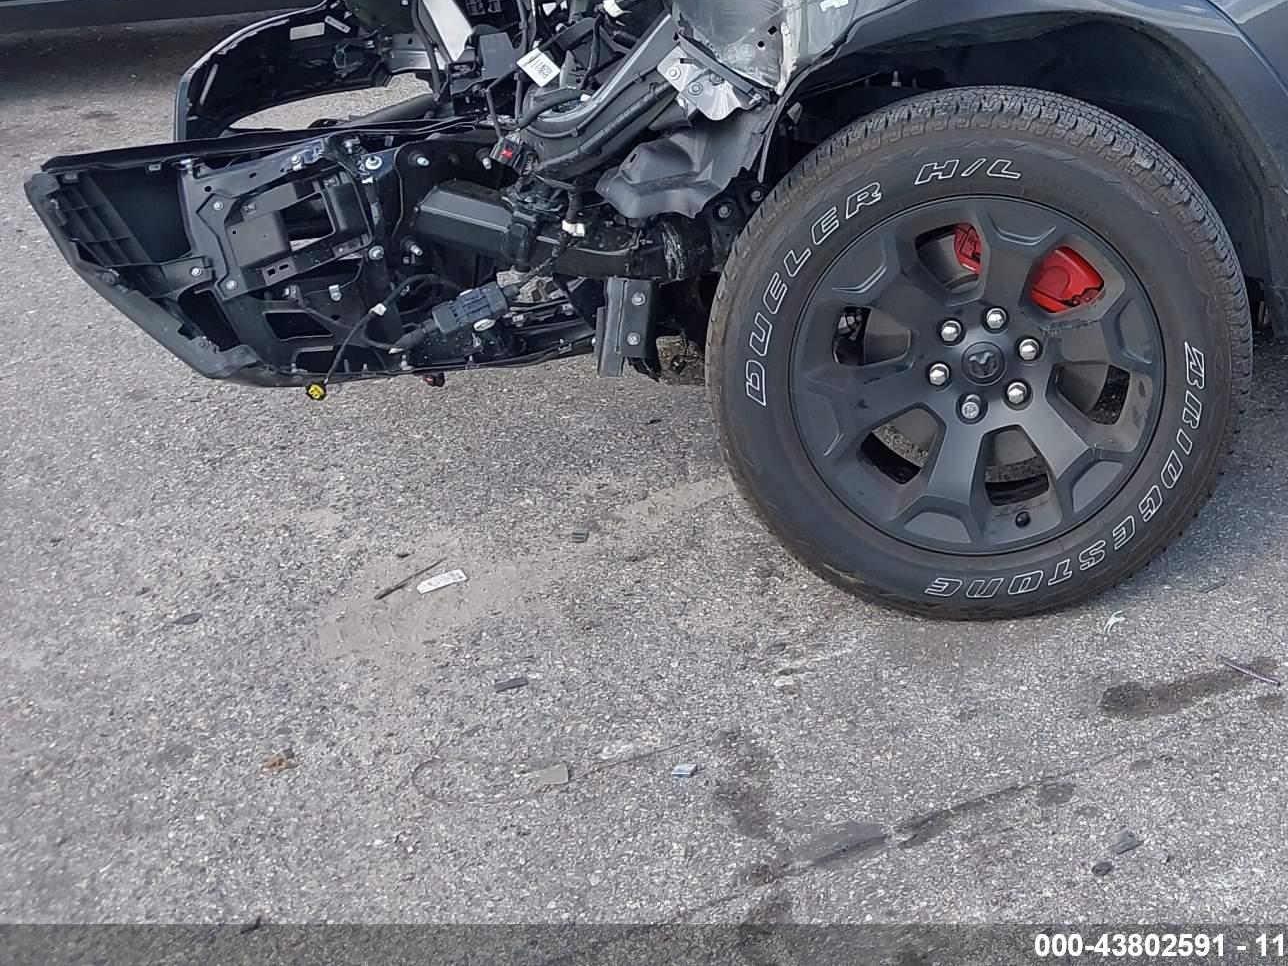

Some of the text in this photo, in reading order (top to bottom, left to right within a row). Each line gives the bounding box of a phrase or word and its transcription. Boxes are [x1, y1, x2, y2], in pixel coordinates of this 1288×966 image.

[745, 156, 1023, 407] DUELER H/L
[924, 341, 1206, 599] BRIDGESTONE
